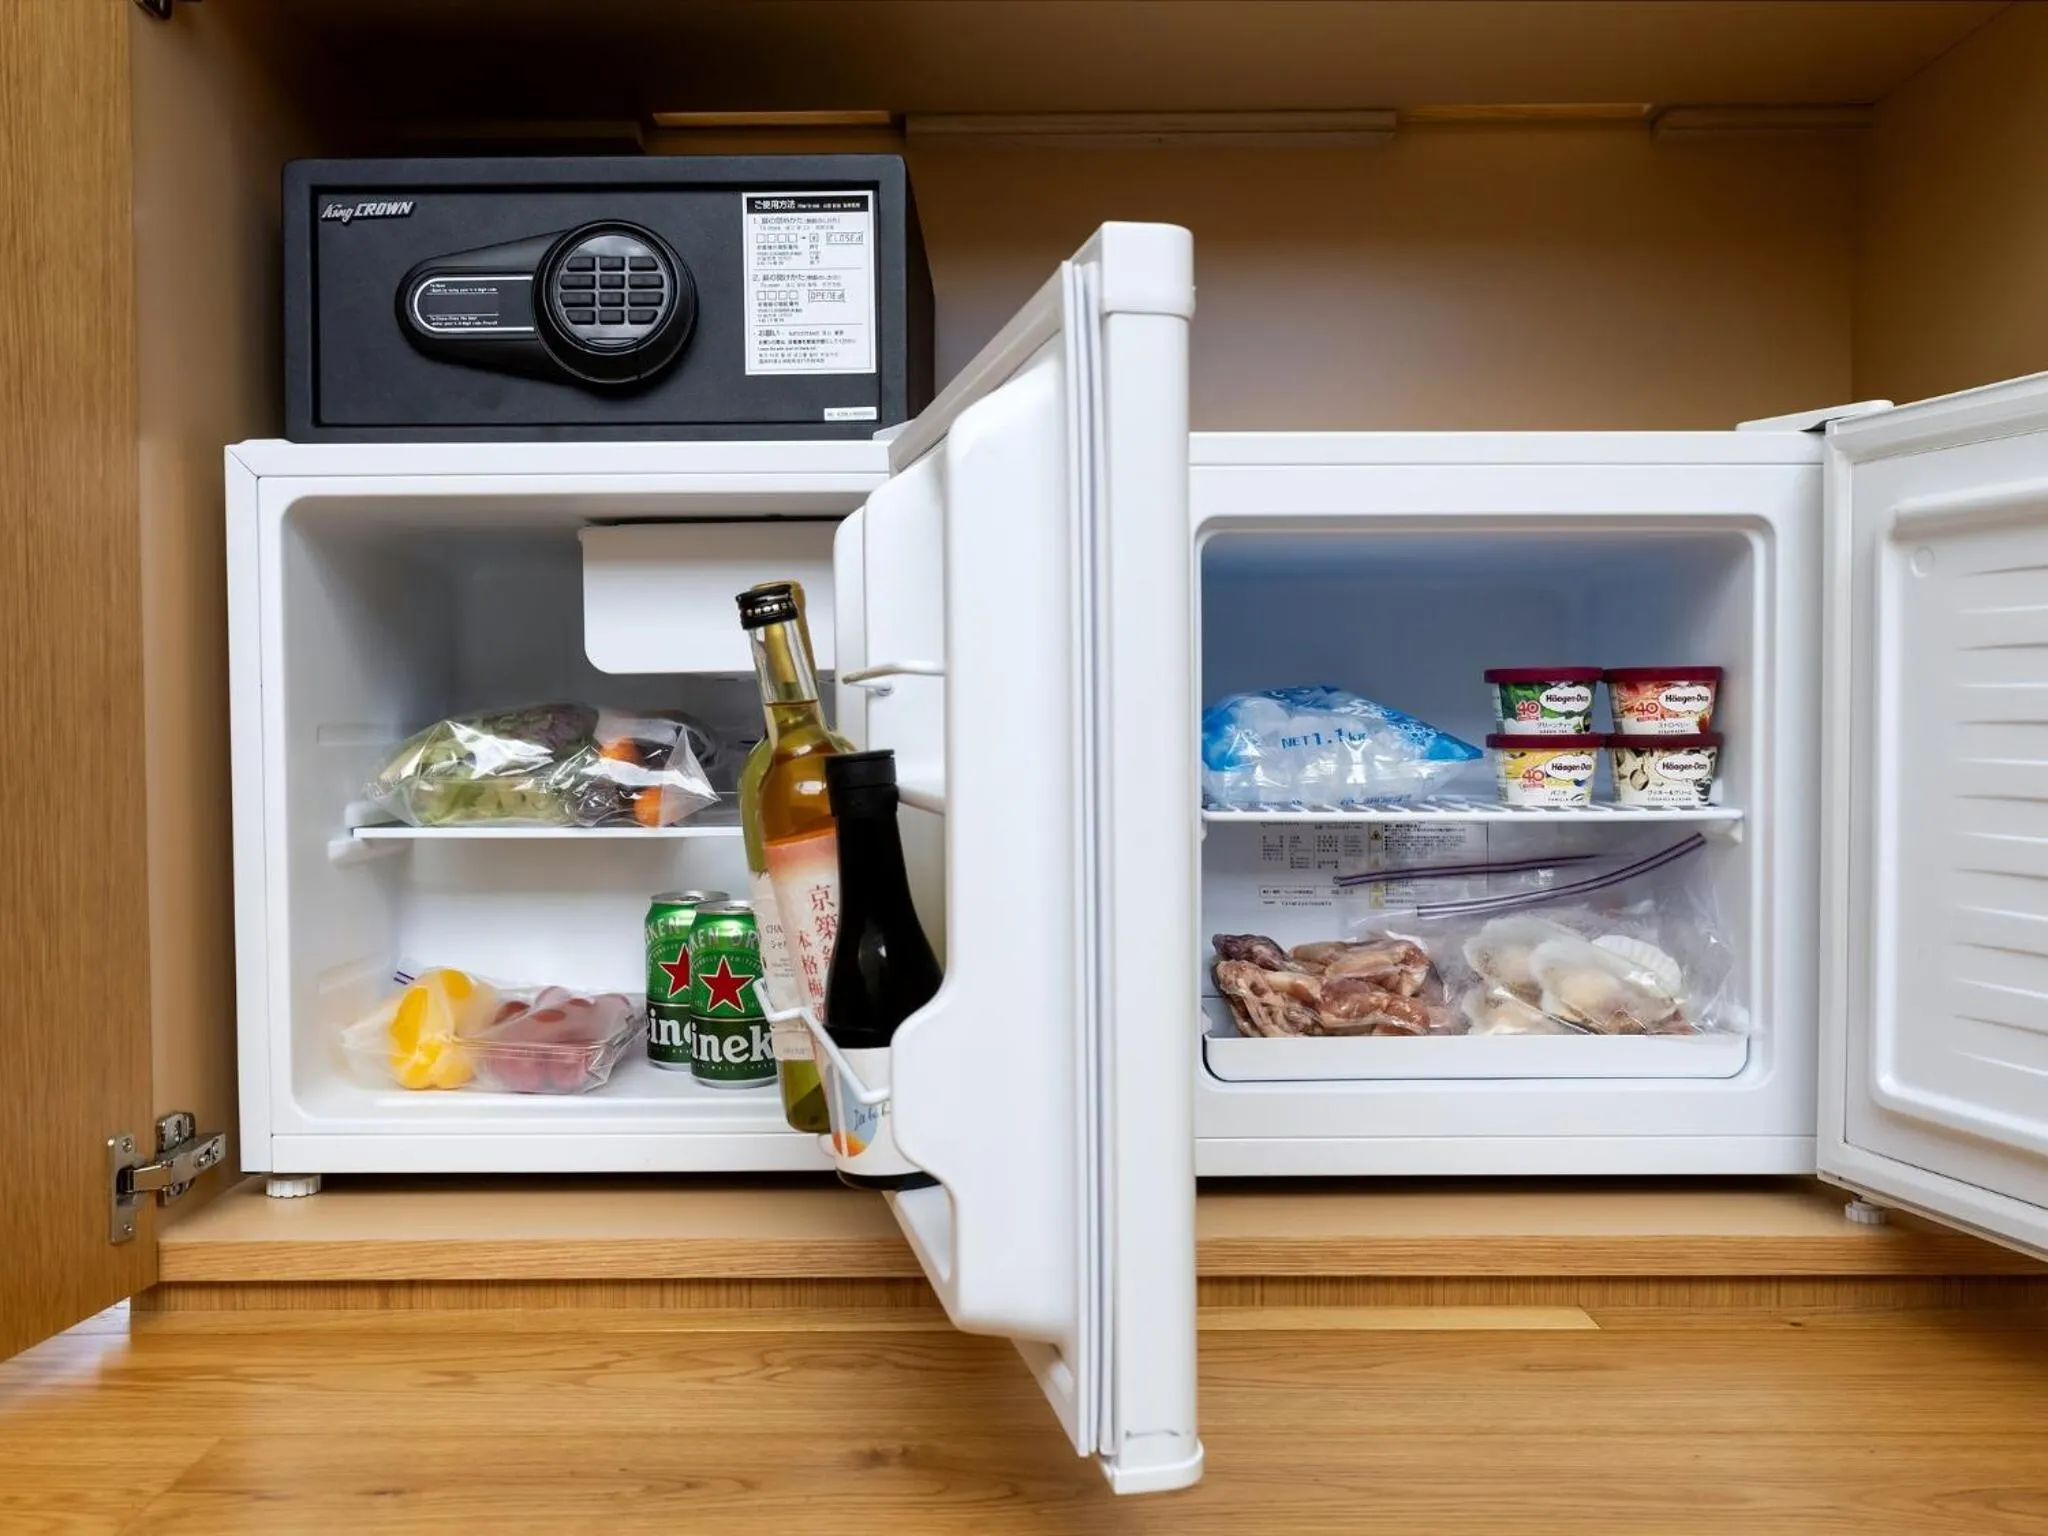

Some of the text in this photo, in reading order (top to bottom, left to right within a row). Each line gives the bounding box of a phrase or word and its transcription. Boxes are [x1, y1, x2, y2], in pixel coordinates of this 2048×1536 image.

[321, 201, 413, 222] King CROWN
[754, 200, 796, 210] ご使用方法
[1517, 702, 1539, 716] 40
[1635, 702, 1659, 716] 40
[1281, 735, 1310, 749] NET
[1522, 769, 1545, 783] 40
